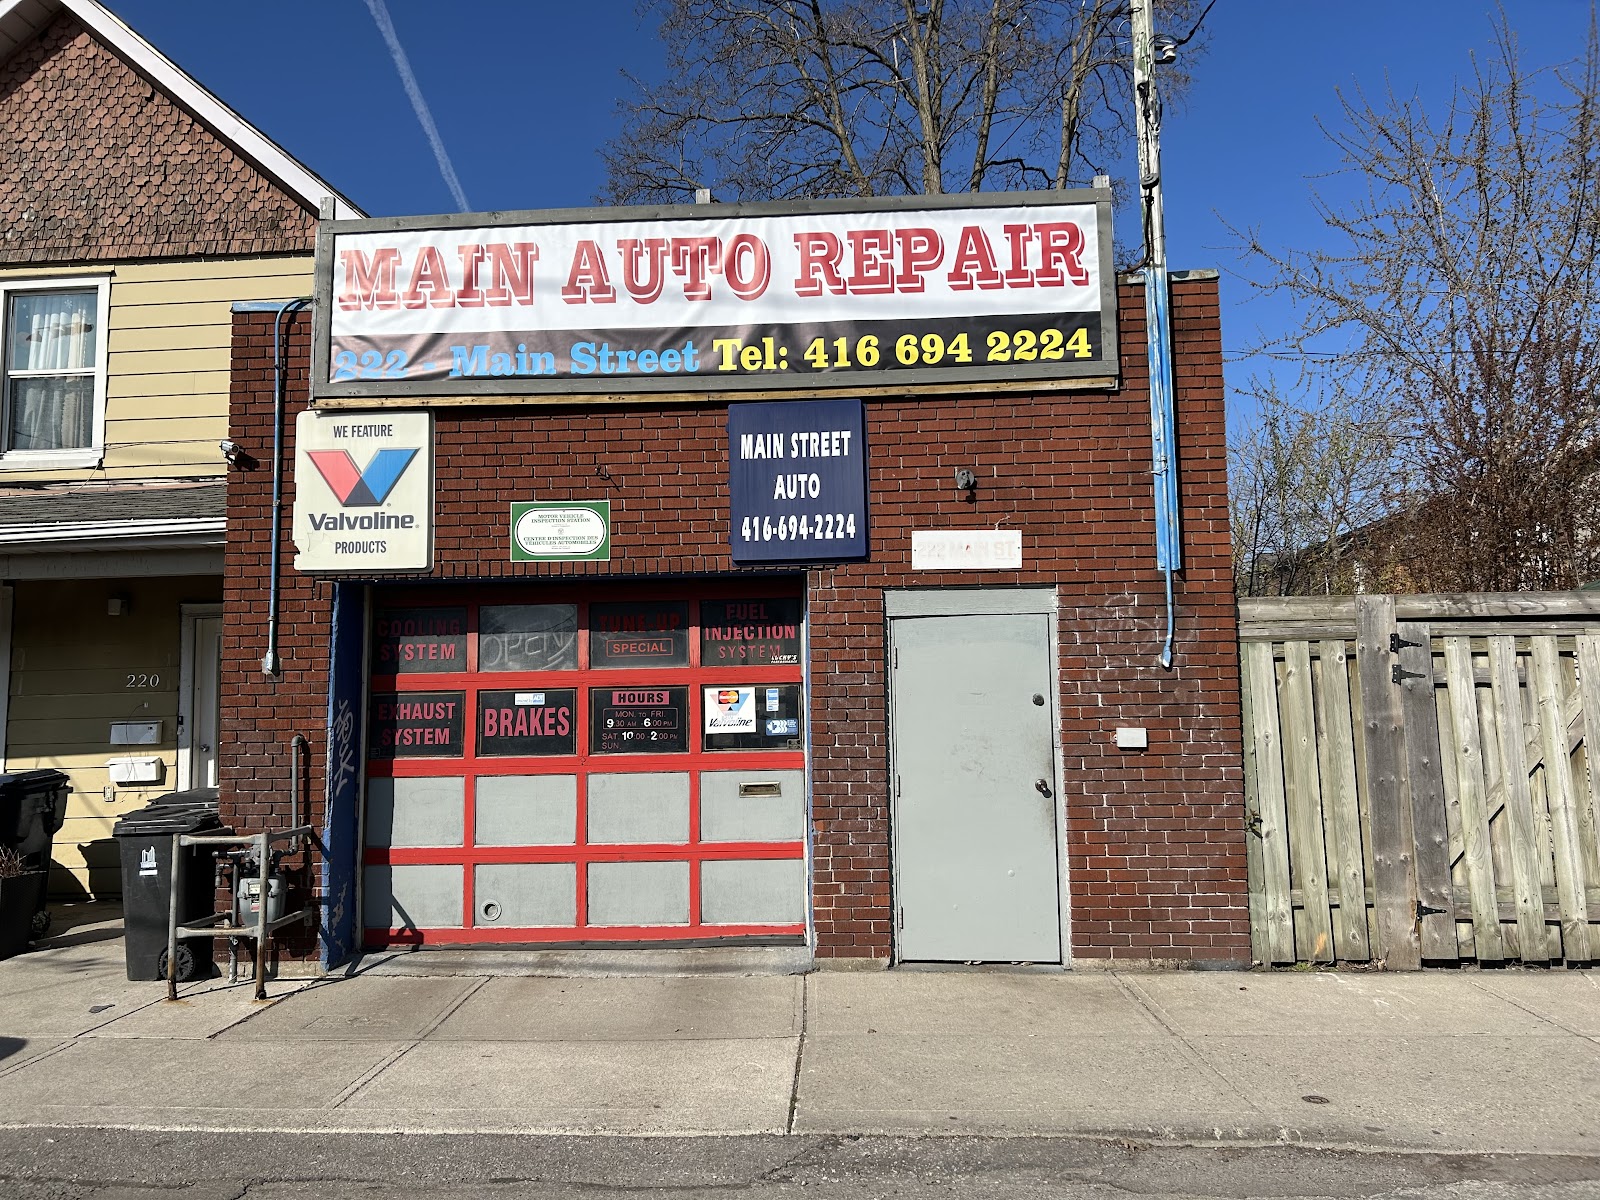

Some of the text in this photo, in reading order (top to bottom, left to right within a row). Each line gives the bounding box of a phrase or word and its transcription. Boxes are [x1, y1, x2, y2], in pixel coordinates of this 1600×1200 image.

[338, 221, 1090, 312] MAIN AUTO REPAIR
[334, 349, 409, 381] 222
[449, 343, 556, 378] Main
[570, 340, 700, 375] Street
[712, 336, 789, 371] Tel:
[803, 334, 880, 369] 416
[895, 332, 973, 366] 694
[986, 327, 1093, 363] 2224
[333, 424, 393, 438] WE FEATURE
[740, 430, 852, 460] MAIN STREET
[773, 472, 821, 500] AUTO
[308, 512, 415, 531] Valvoline
[741, 513, 856, 542] 416-694-2224
[335, 540, 387, 554] PRODUCTS
[725, 603, 768, 620] FUEL
[376, 617, 460, 637] COOLING
[600, 612, 681, 633] TUNE-UP
[704, 623, 796, 641] INJECTION
[379, 643, 456, 661] SYSTEM
[612, 642, 667, 654] SPECIAL
[719, 644, 781, 659] SYSTEM
[126, 674, 160, 688] 220
[618, 692, 664, 703] HOURS
[378, 702, 456, 721] EXHAUST
[615, 710, 636, 718] MON.
[484, 706, 571, 737] BRAKES
[380, 727, 450, 746] SYSTEM
